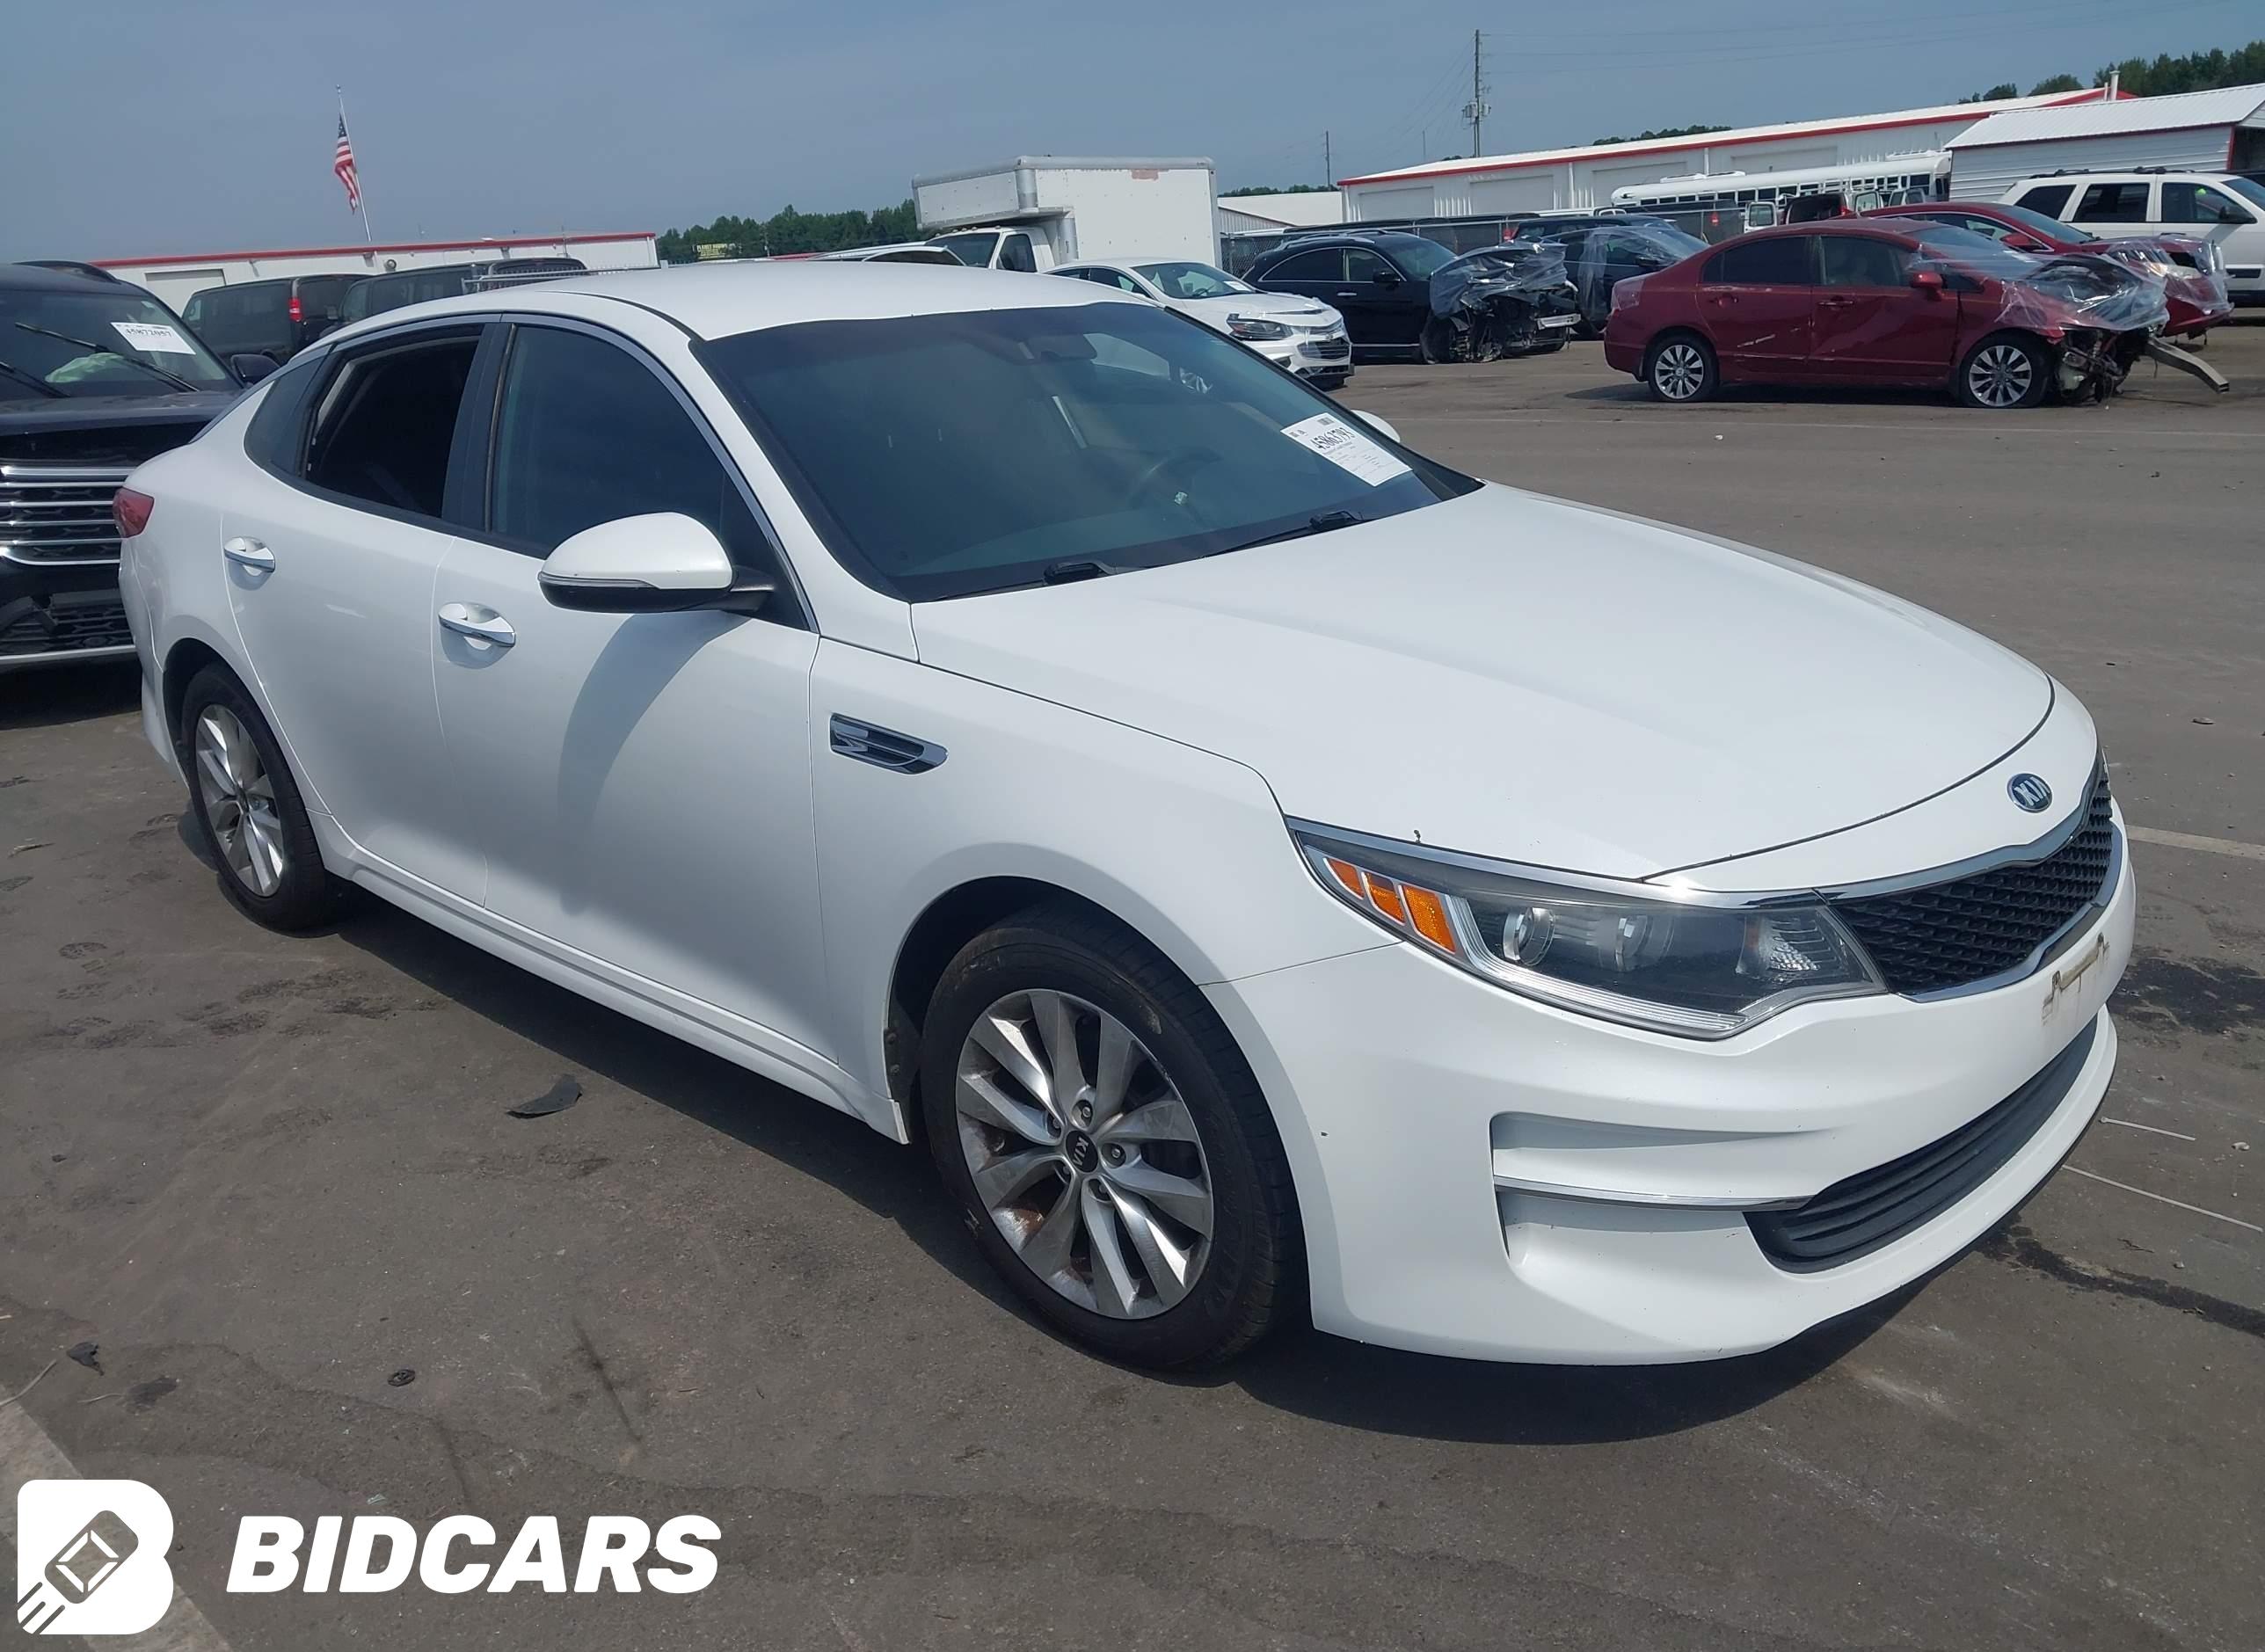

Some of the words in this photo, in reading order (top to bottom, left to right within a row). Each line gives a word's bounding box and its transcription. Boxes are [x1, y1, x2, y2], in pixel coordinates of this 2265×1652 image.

[1309, 426, 1355, 450] 45863793
[2014, 776, 2050, 806] KIA
[1072, 1136, 1089, 1167] KIA
